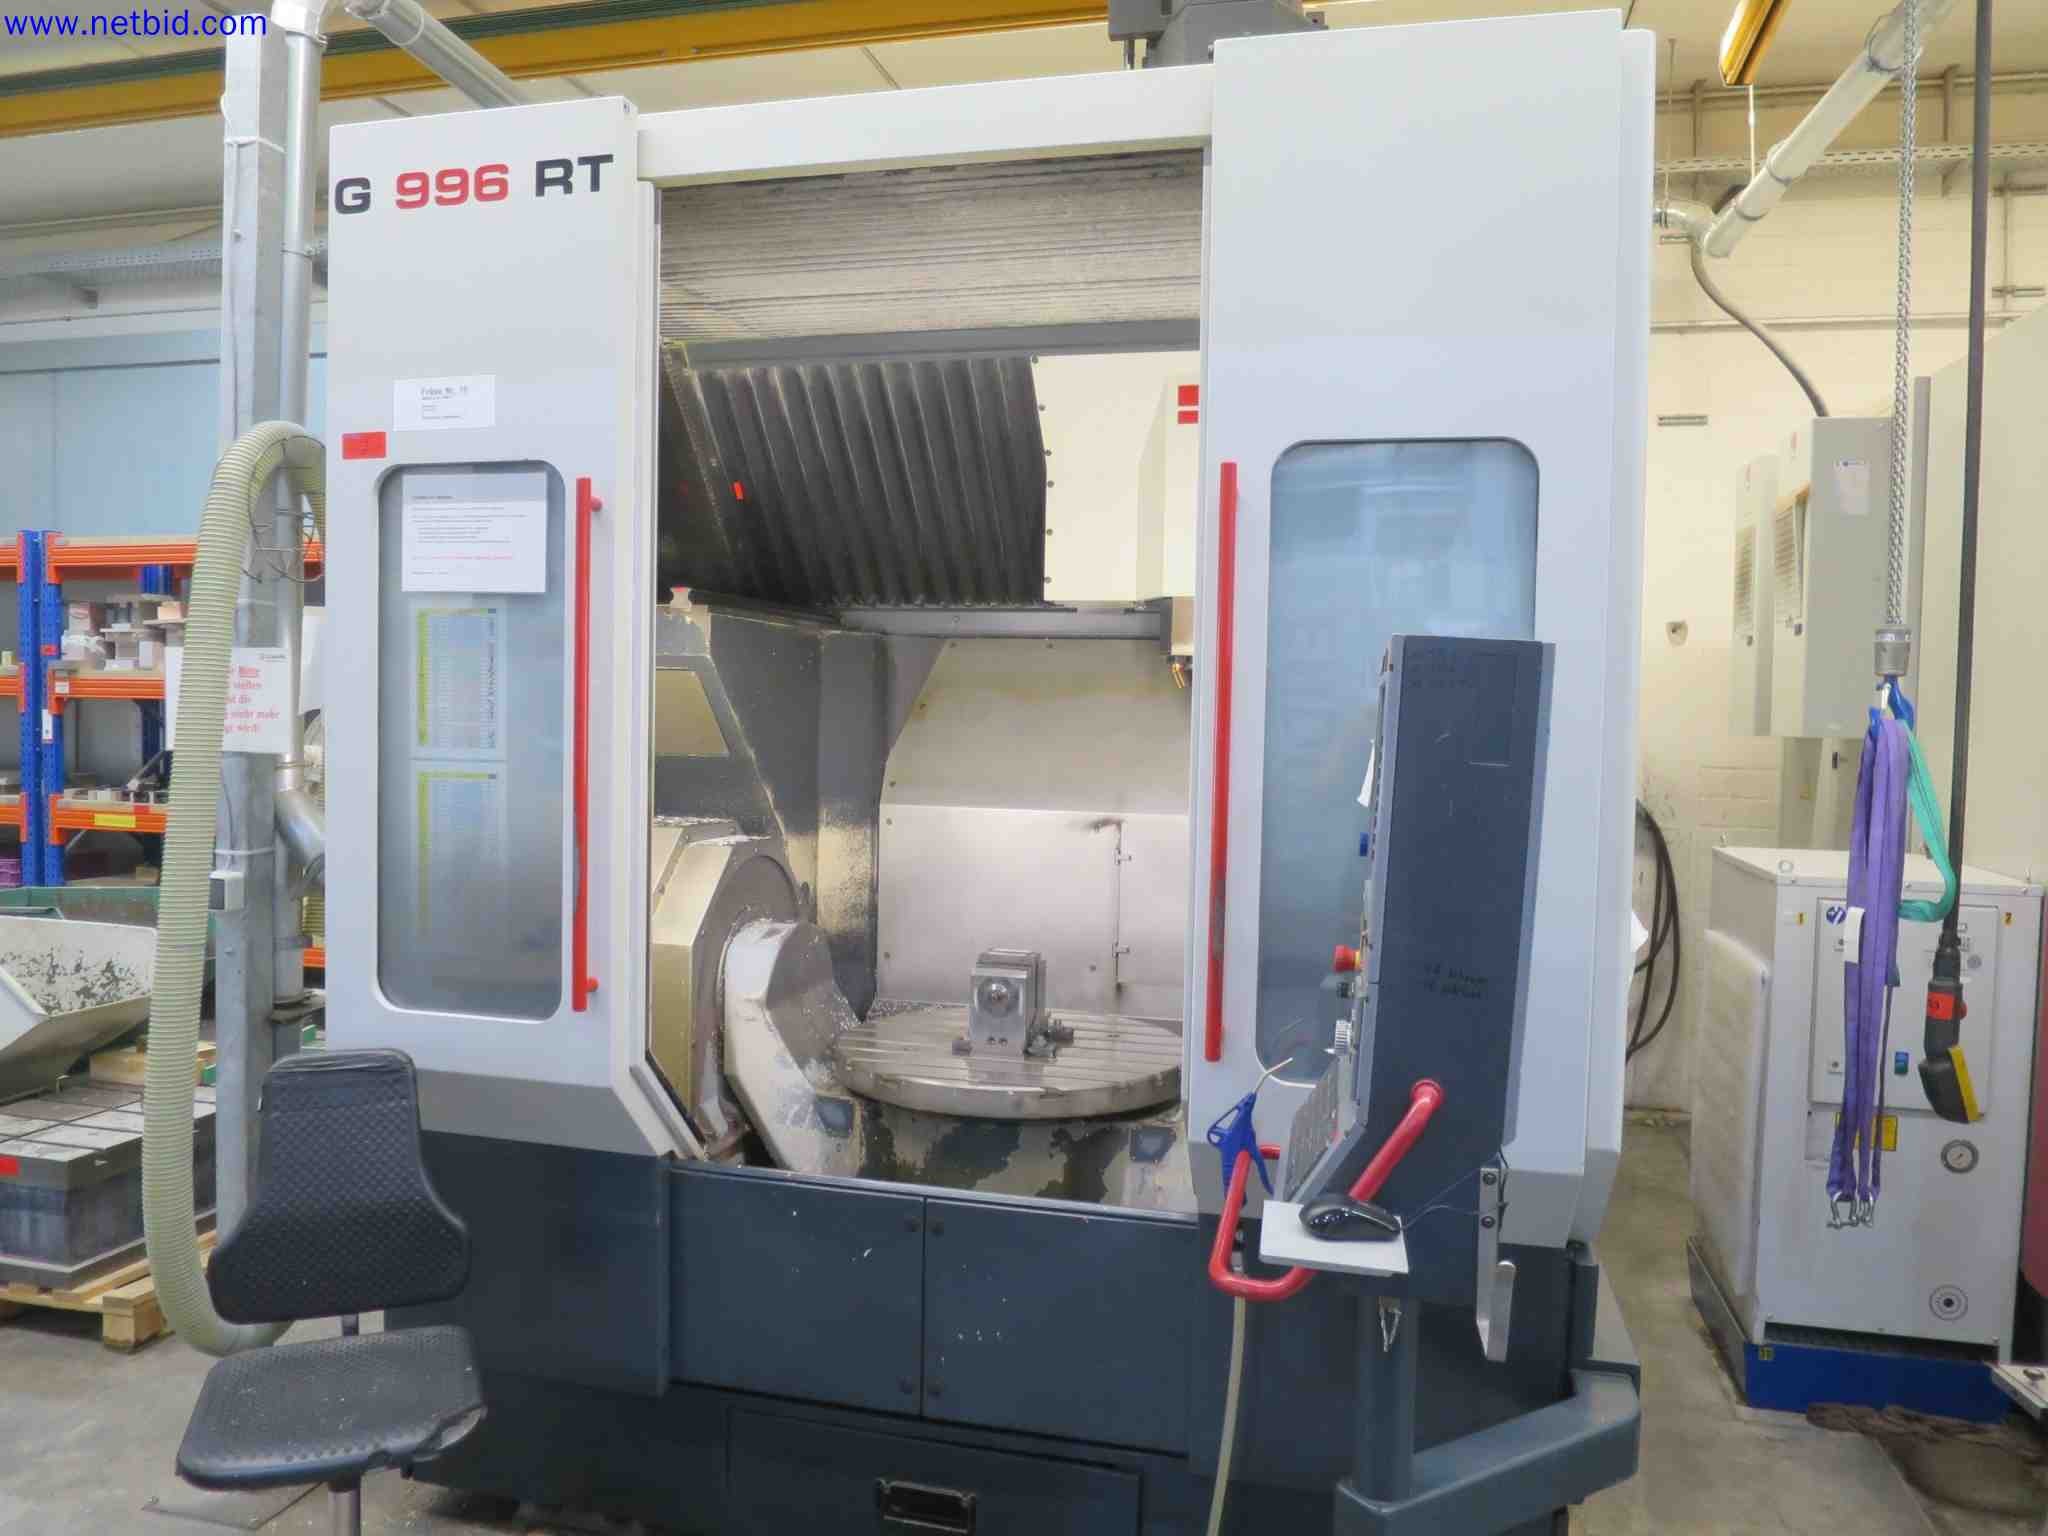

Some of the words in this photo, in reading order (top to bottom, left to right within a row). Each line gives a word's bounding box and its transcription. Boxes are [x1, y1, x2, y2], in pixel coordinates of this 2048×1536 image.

[335, 177, 371, 214] G
[395, 163, 510, 209] 996
[535, 154, 614, 197] RT
